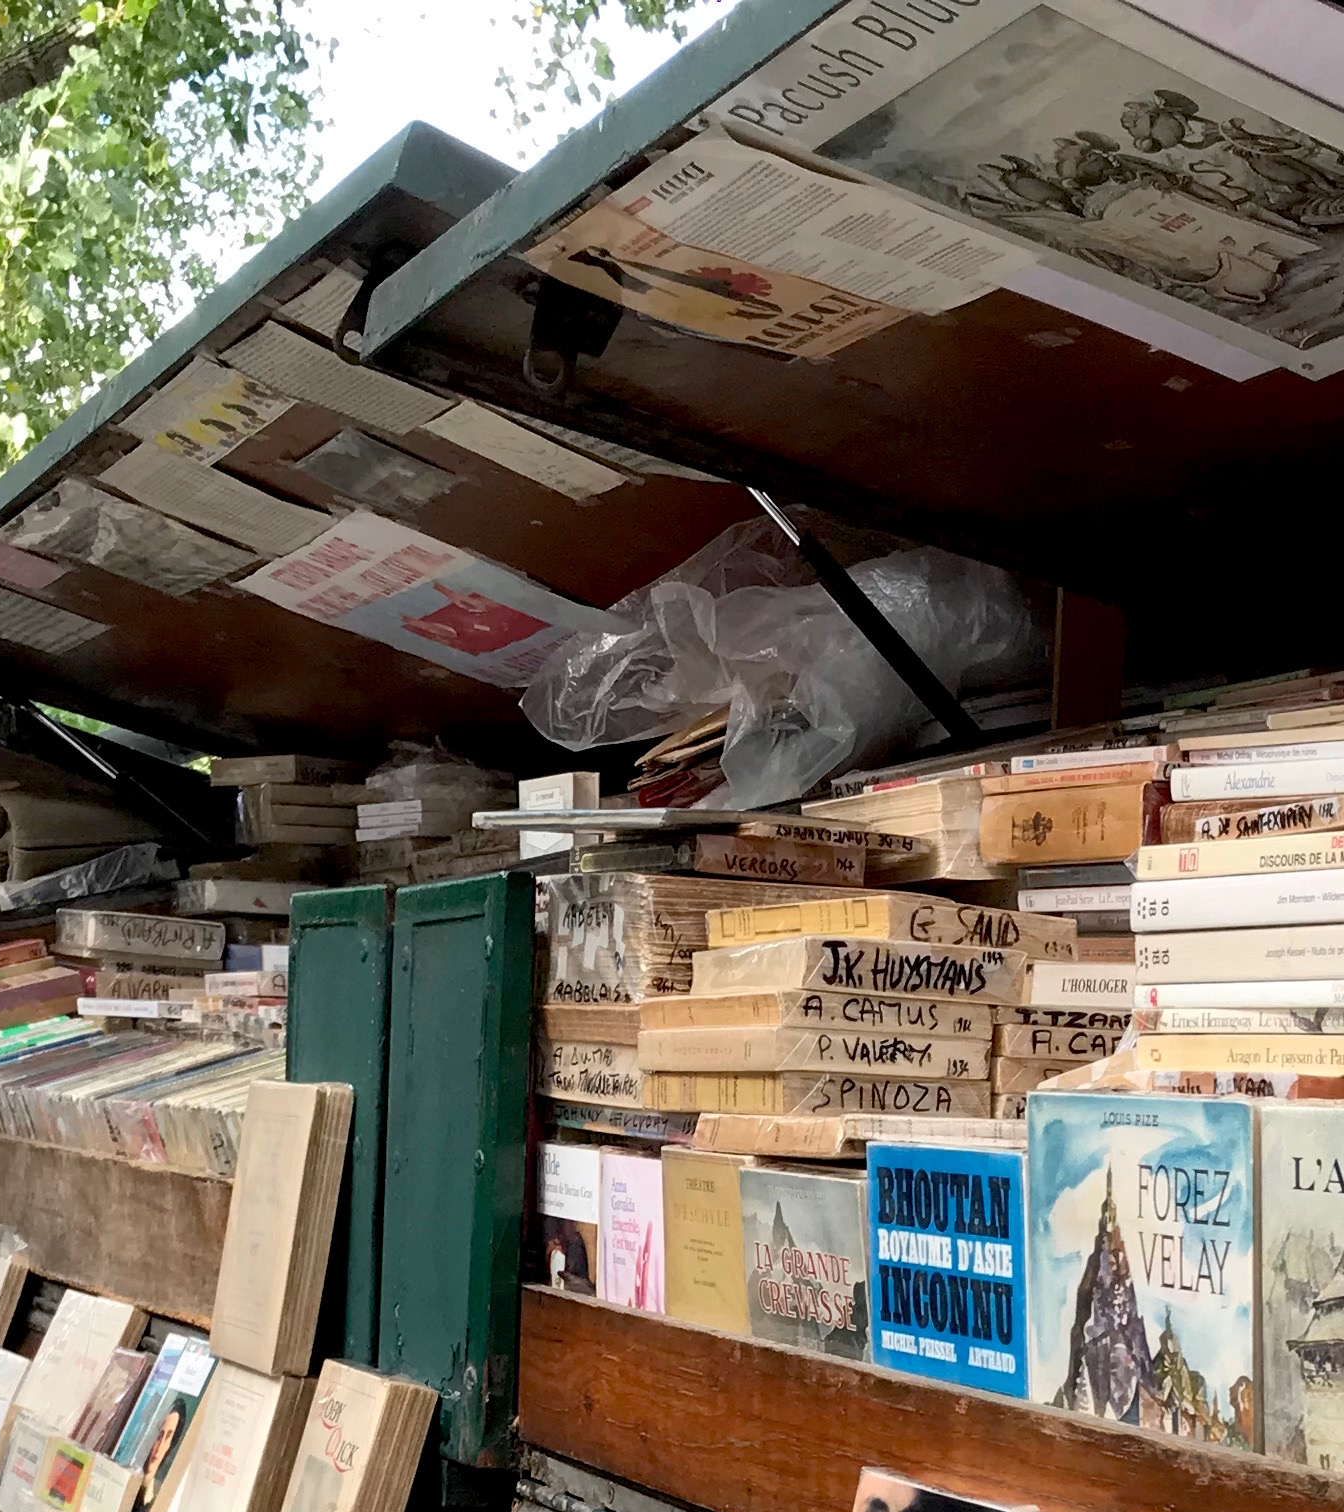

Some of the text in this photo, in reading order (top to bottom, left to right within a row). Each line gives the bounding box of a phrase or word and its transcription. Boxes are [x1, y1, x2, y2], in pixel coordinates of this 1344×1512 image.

[728, 0, 980, 137] Pacush Blu
[1225, 771, 1276, 792] Alexandrie
[724, 852, 799, 878] VERCORS
[1259, 851, 1307, 868] DISCOURS
[1309, 851, 1323, 866] DE
[1325, 850, 1338, 865] LA
[1061, 977, 1128, 994] L'HORLOGER
[843, 999, 939, 1031] CAMUS
[1171, 1012, 1200, 1030] Ernest
[1201, 1012, 1253, 1033] Hemingway
[1226, 1047, 1261, 1064] Aragon
[1265, 1046, 1279, 1064] Le
[1280, 1050, 1313, 1068] paysan
[1315, 1047, 1328, 1064] de
[814, 1080, 953, 1113] SPINOZA
[611, 1177, 628, 1194] Anna
[876, 1166, 1011, 1240] BHOUTAN
[1136, 1162, 1232, 1228] FOREZ
[754, 1240, 774, 1274] LA
[782, 1244, 852, 1288] GRANDE
[878, 1228, 1013, 1279] ROYAUME D'ASIE
[1137, 1230, 1233, 1297] VELAY
[758, 1278, 858, 1333] CREVASSE
[879, 1265, 1015, 1346] INCONNU
[880, 1330, 1017, 1375] MICHEL PEISSEL ARTHAUD
